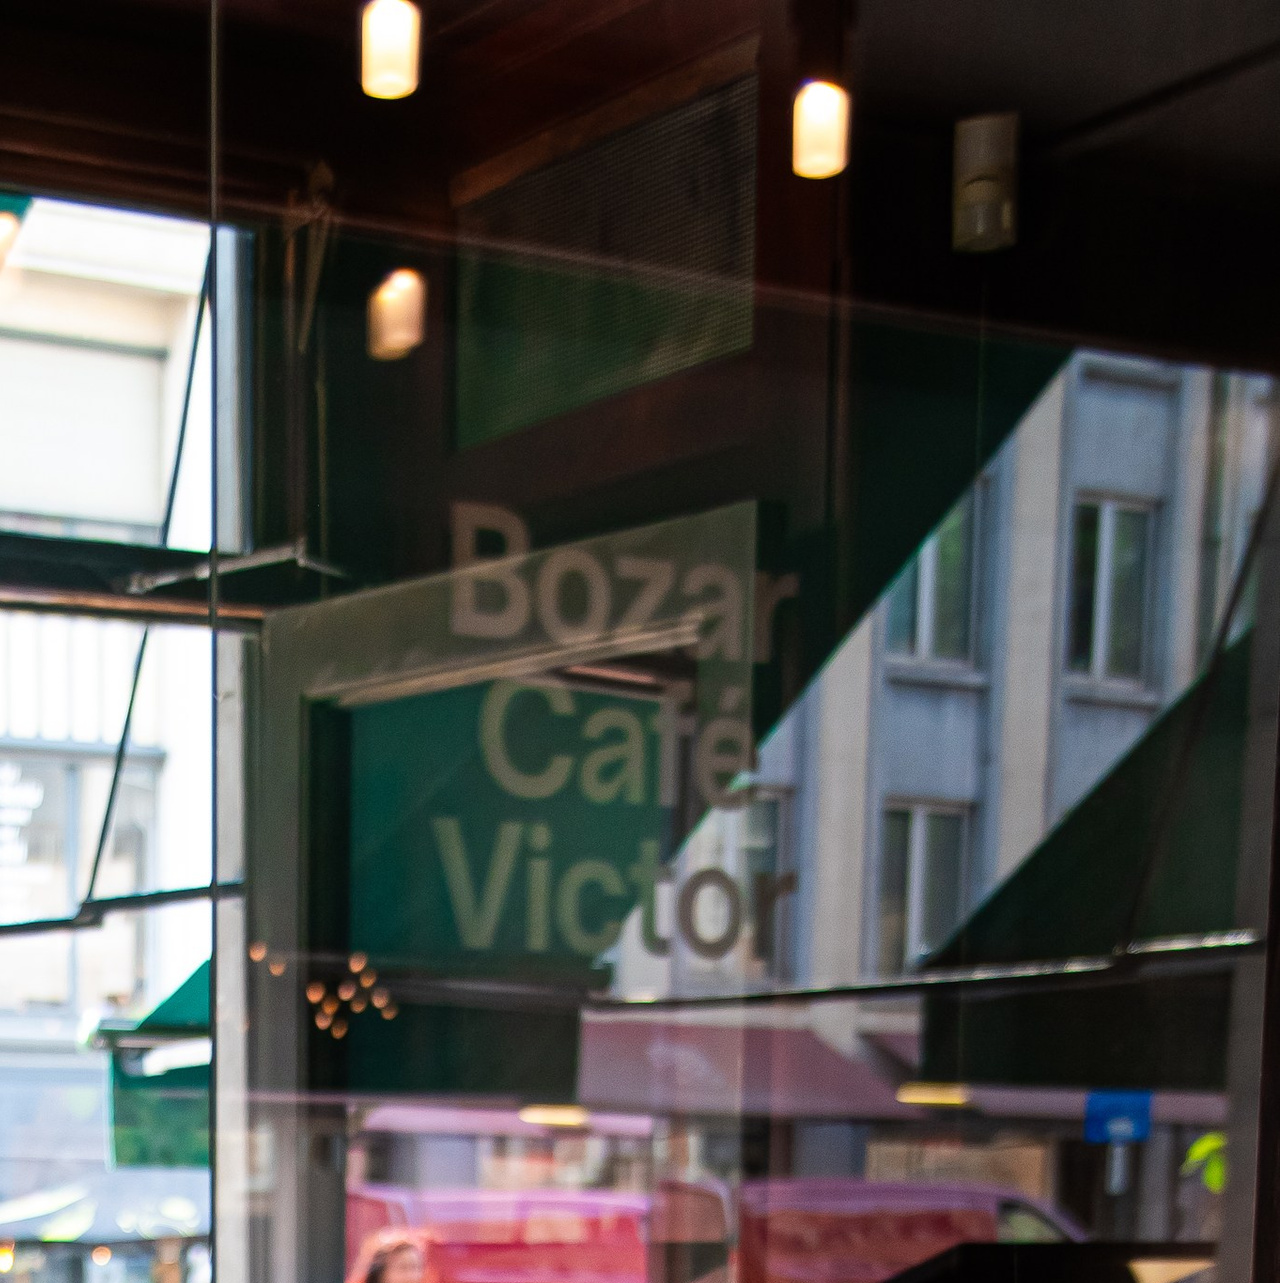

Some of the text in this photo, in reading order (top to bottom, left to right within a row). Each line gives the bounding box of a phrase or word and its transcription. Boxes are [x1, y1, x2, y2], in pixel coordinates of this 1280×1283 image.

[451, 501, 799, 664] Bozar
[478, 677, 757, 808] Café
[431, 815, 797, 967] Victor
